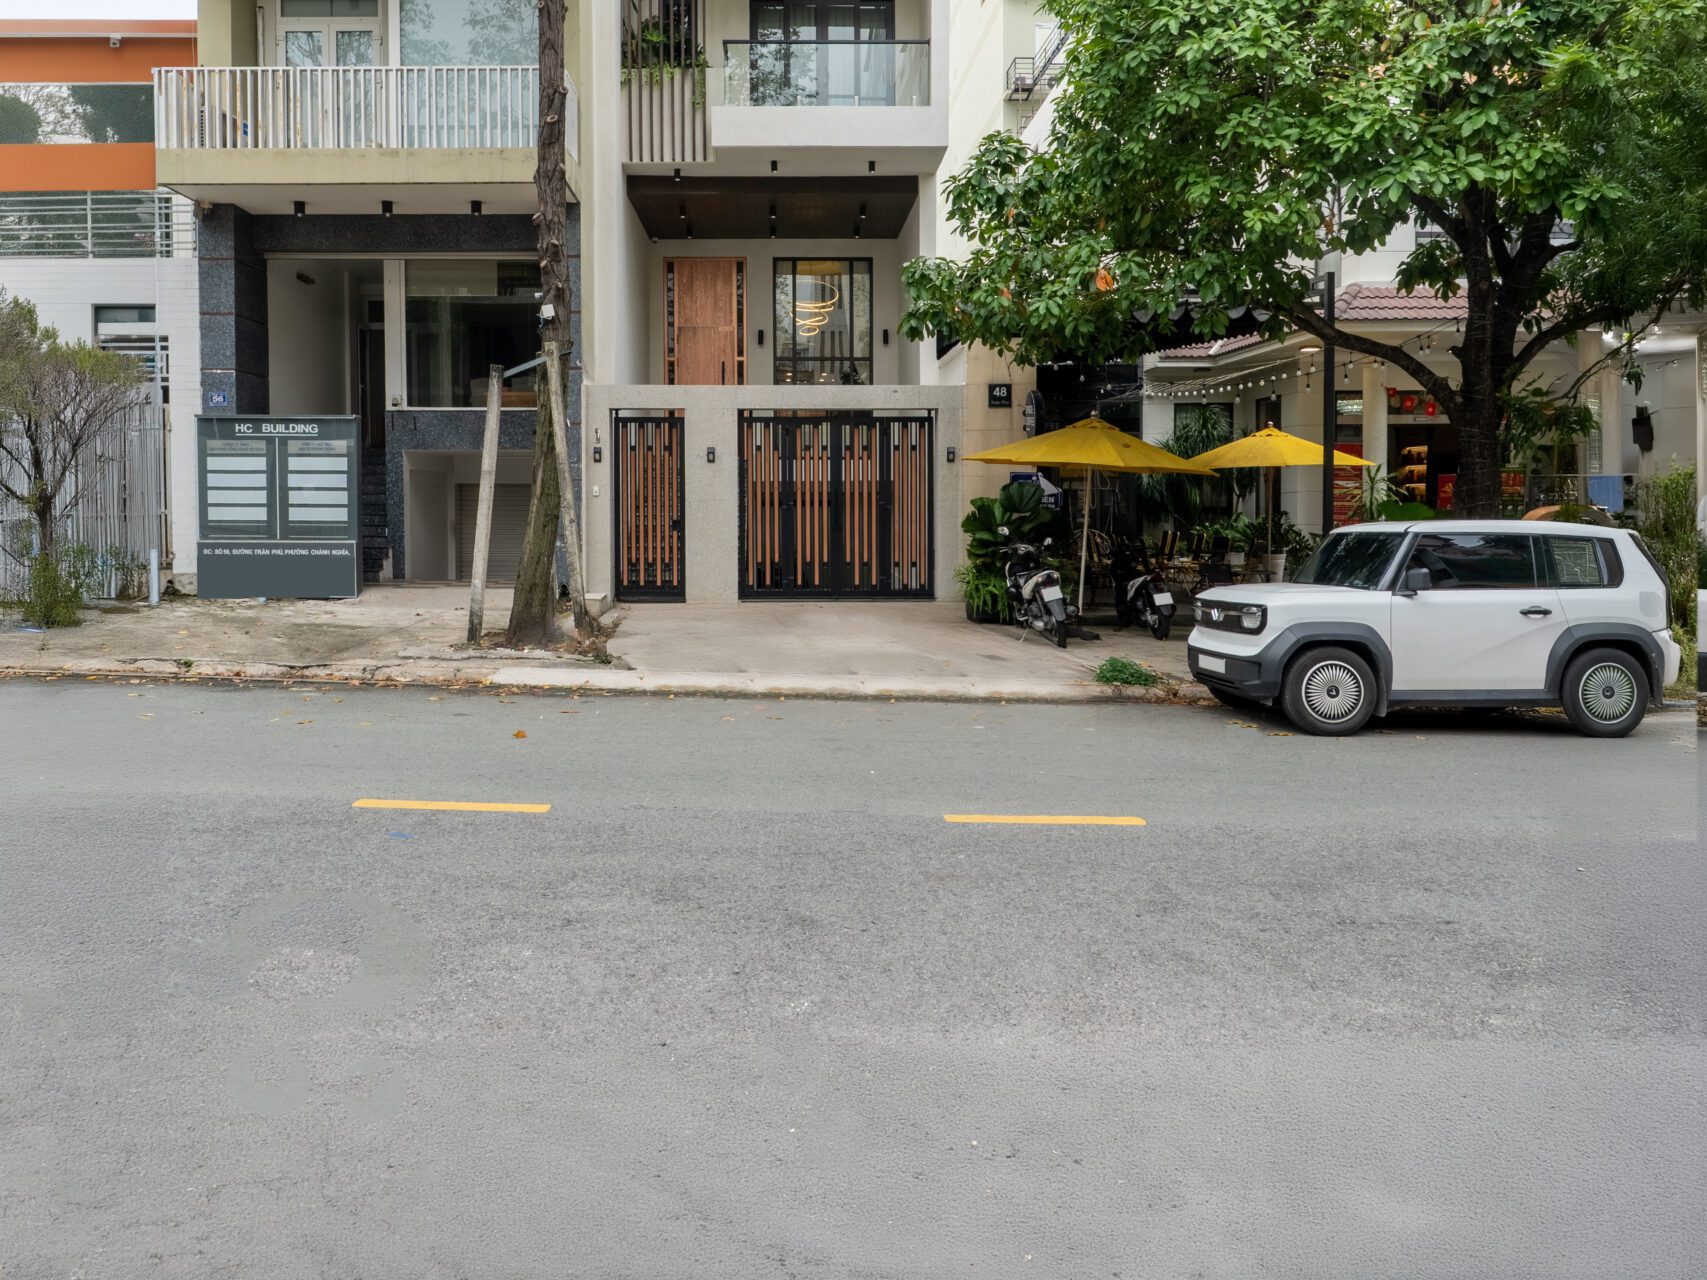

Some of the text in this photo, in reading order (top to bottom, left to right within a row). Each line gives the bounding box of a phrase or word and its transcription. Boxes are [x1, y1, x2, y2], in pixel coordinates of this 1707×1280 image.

[993, 386, 1008, 397] 48
[212, 395, 224, 403] 56
[235, 423, 319, 434] HC BUILDING
